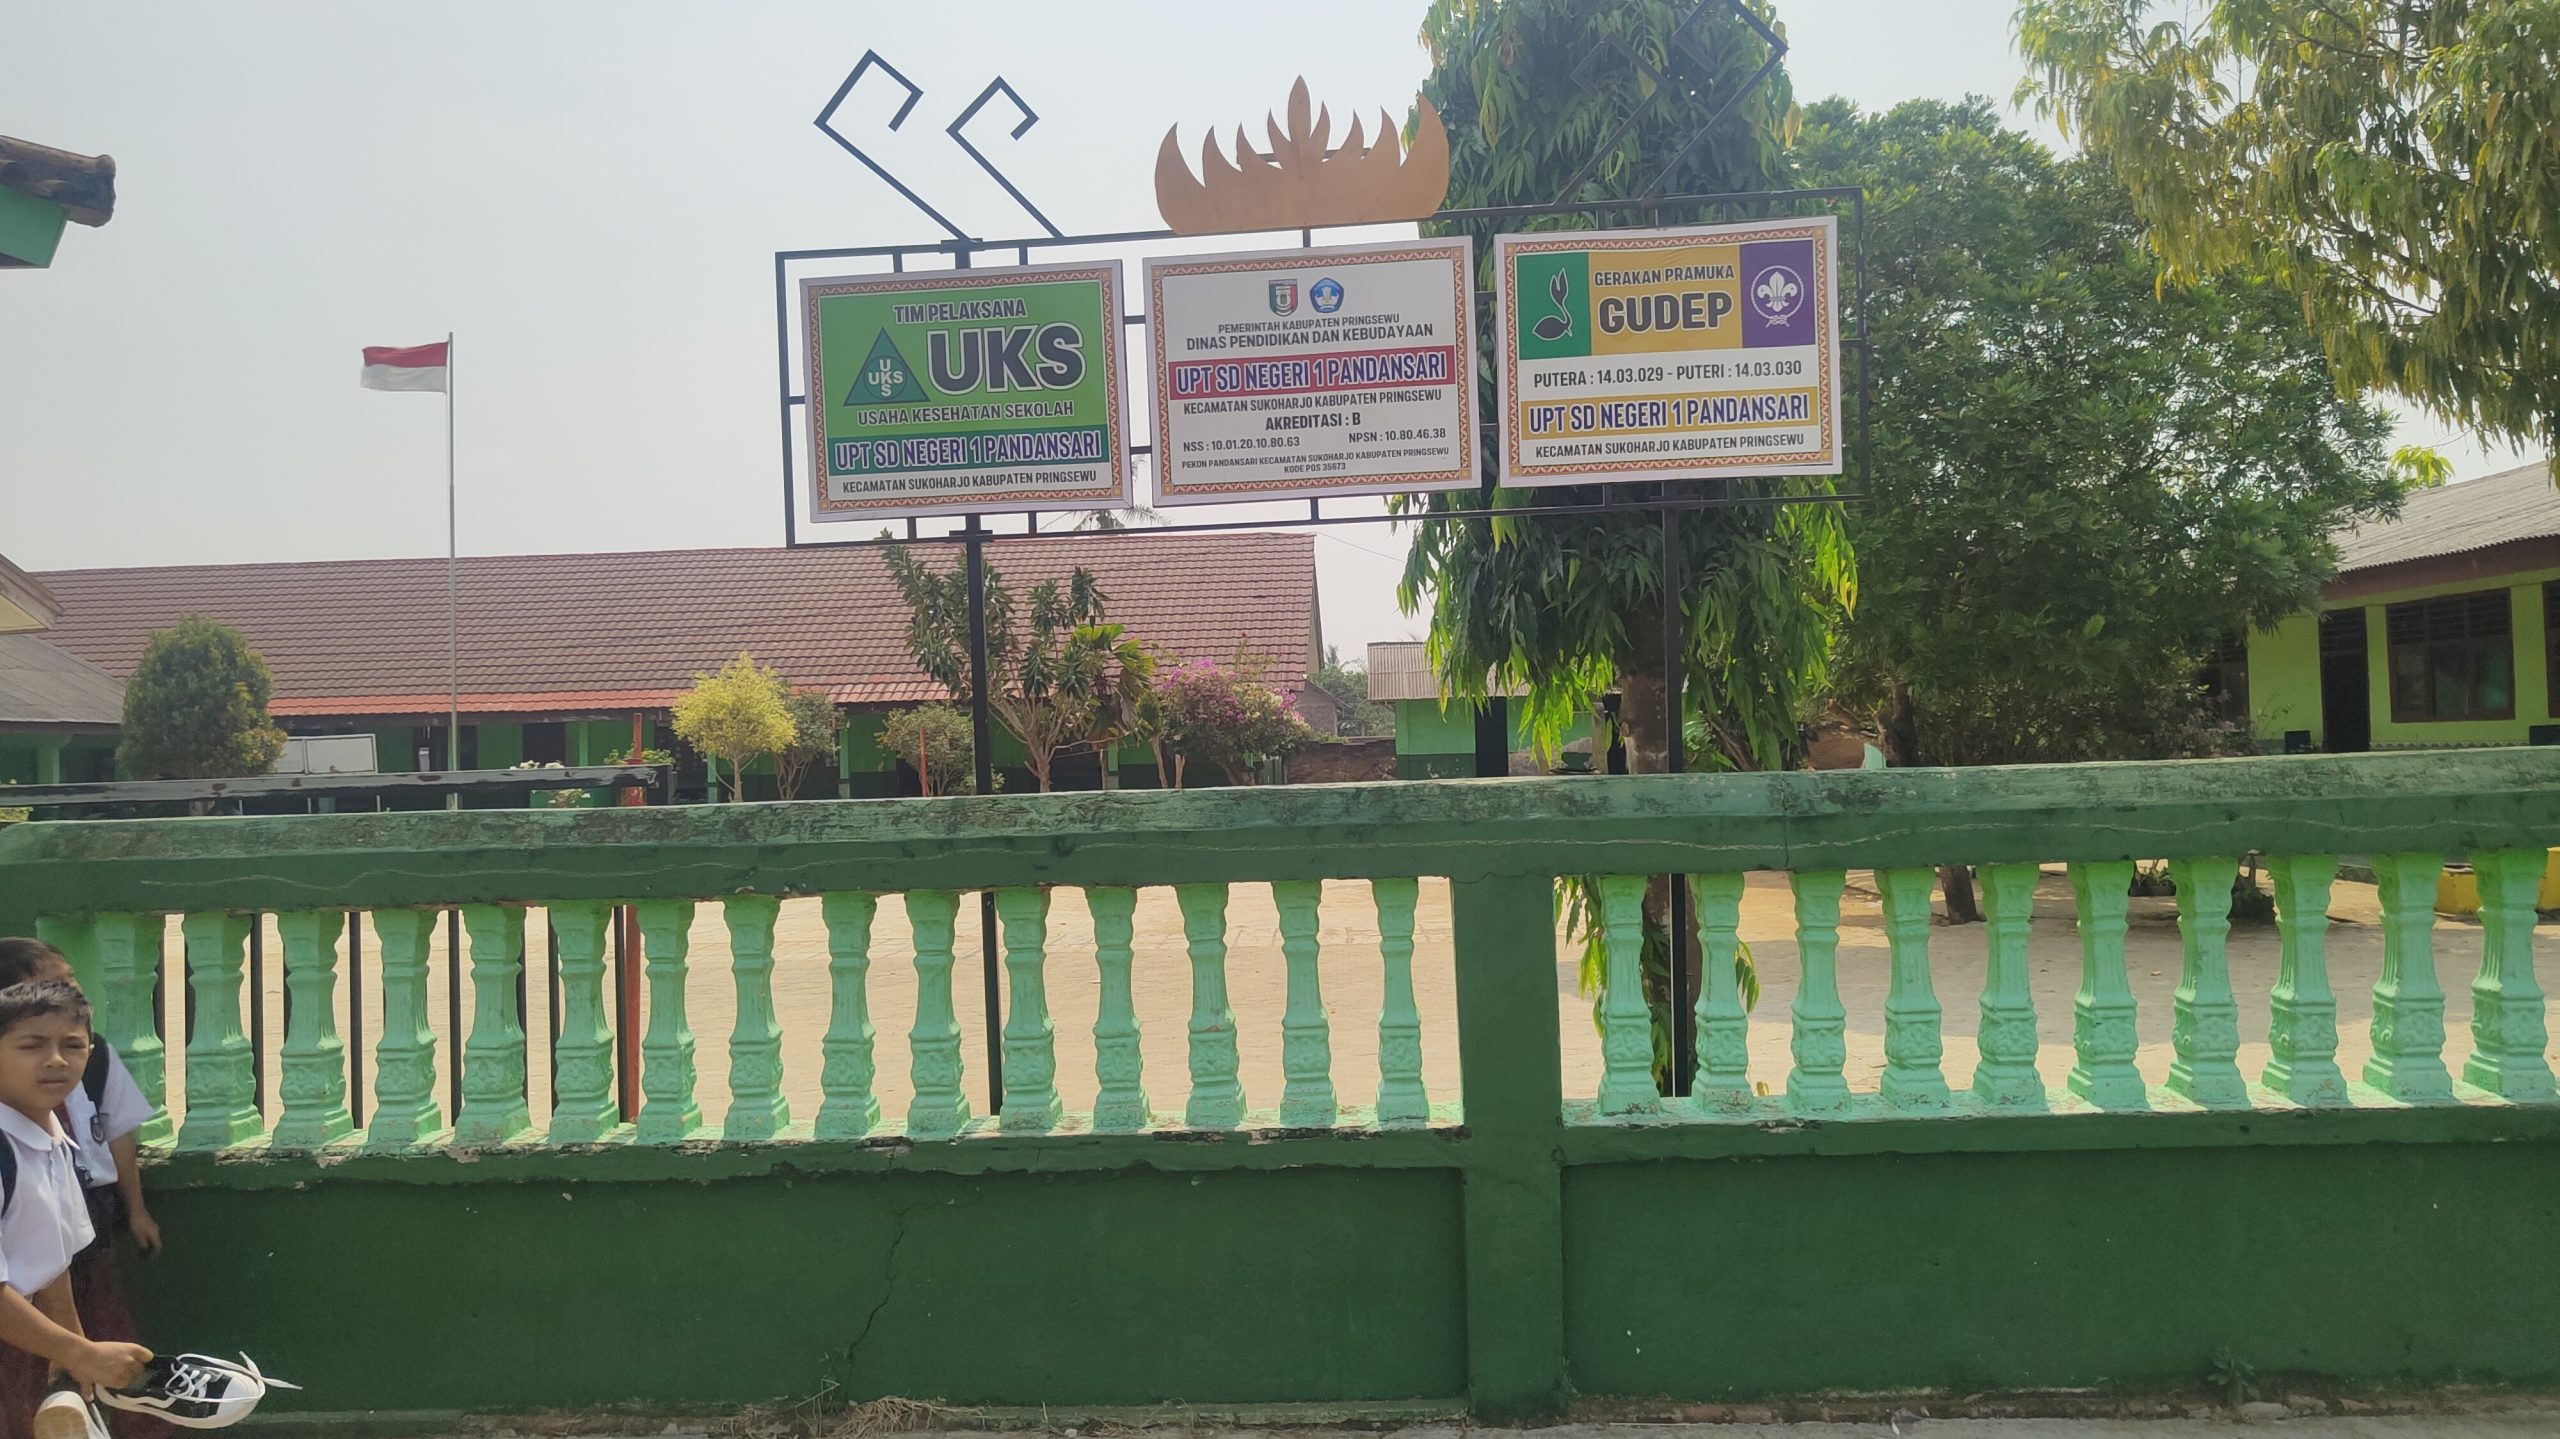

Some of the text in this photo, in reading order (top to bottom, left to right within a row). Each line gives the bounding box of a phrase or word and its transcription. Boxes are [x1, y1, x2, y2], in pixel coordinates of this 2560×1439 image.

[1594, 264, 1734, 286] GERAKAN PRAMUKA
[894, 299, 1026, 324] TIM PELAKSANA
[1218, 314, 1400, 333] PEMERINTAH KABUPATEN PRINGSEWU
[1599, 292, 1732, 334] GUDEP
[1187, 324, 1433, 350] DINAS PENDIDIKAN DAN KEBUDAYAAN
[927, 322, 1086, 395] UKS
[1176, 352, 1447, 394] UPT SD NEGERI 1 PANDANSARI
[1534, 373, 1586, 388] PUTERA
[1596, 367, 1663, 384] 14.03.029
[1676, 365, 1724, 380] PUTERI
[1735, 360, 1801, 377] 14.03.030
[857, 401, 1074, 426] USAHA KESEHATAN SEKOLAH
[1184, 389, 1441, 415] KECAMATAN SUKOHARJO KABUPATEN PRINGSEWU
[1529, 394, 1810, 434] UPT SD NEGERI 1 PANDANSARI
[1266, 413, 1342, 431] AKREDITASI
[1352, 412, 1360, 425] B
[1184, 441, 1204, 452] NSS
[1212, 437, 1300, 450] 10.01.20.10.80.63
[1349, 432, 1377, 443] NPSN
[1385, 428, 1446, 441] 10.80.46.38
[1536, 434, 1804, 458] KECAMATAN SUKOHARJO KABUPATEN PRINGSEWU
[835, 431, 1101, 471] UPT SD NEGERI 1 PANDANSARI
[1182, 447, 1449, 469] PEKON PANDANSARI KECAMATAN SUKOHARJO KABUPATEN PRINGSEWU
[1284, 463, 1345, 473] KODE POS 35673
[843, 470, 1096, 493] KECAMATAN SUKOHARJO KABUPATEN PRINGSEWU
